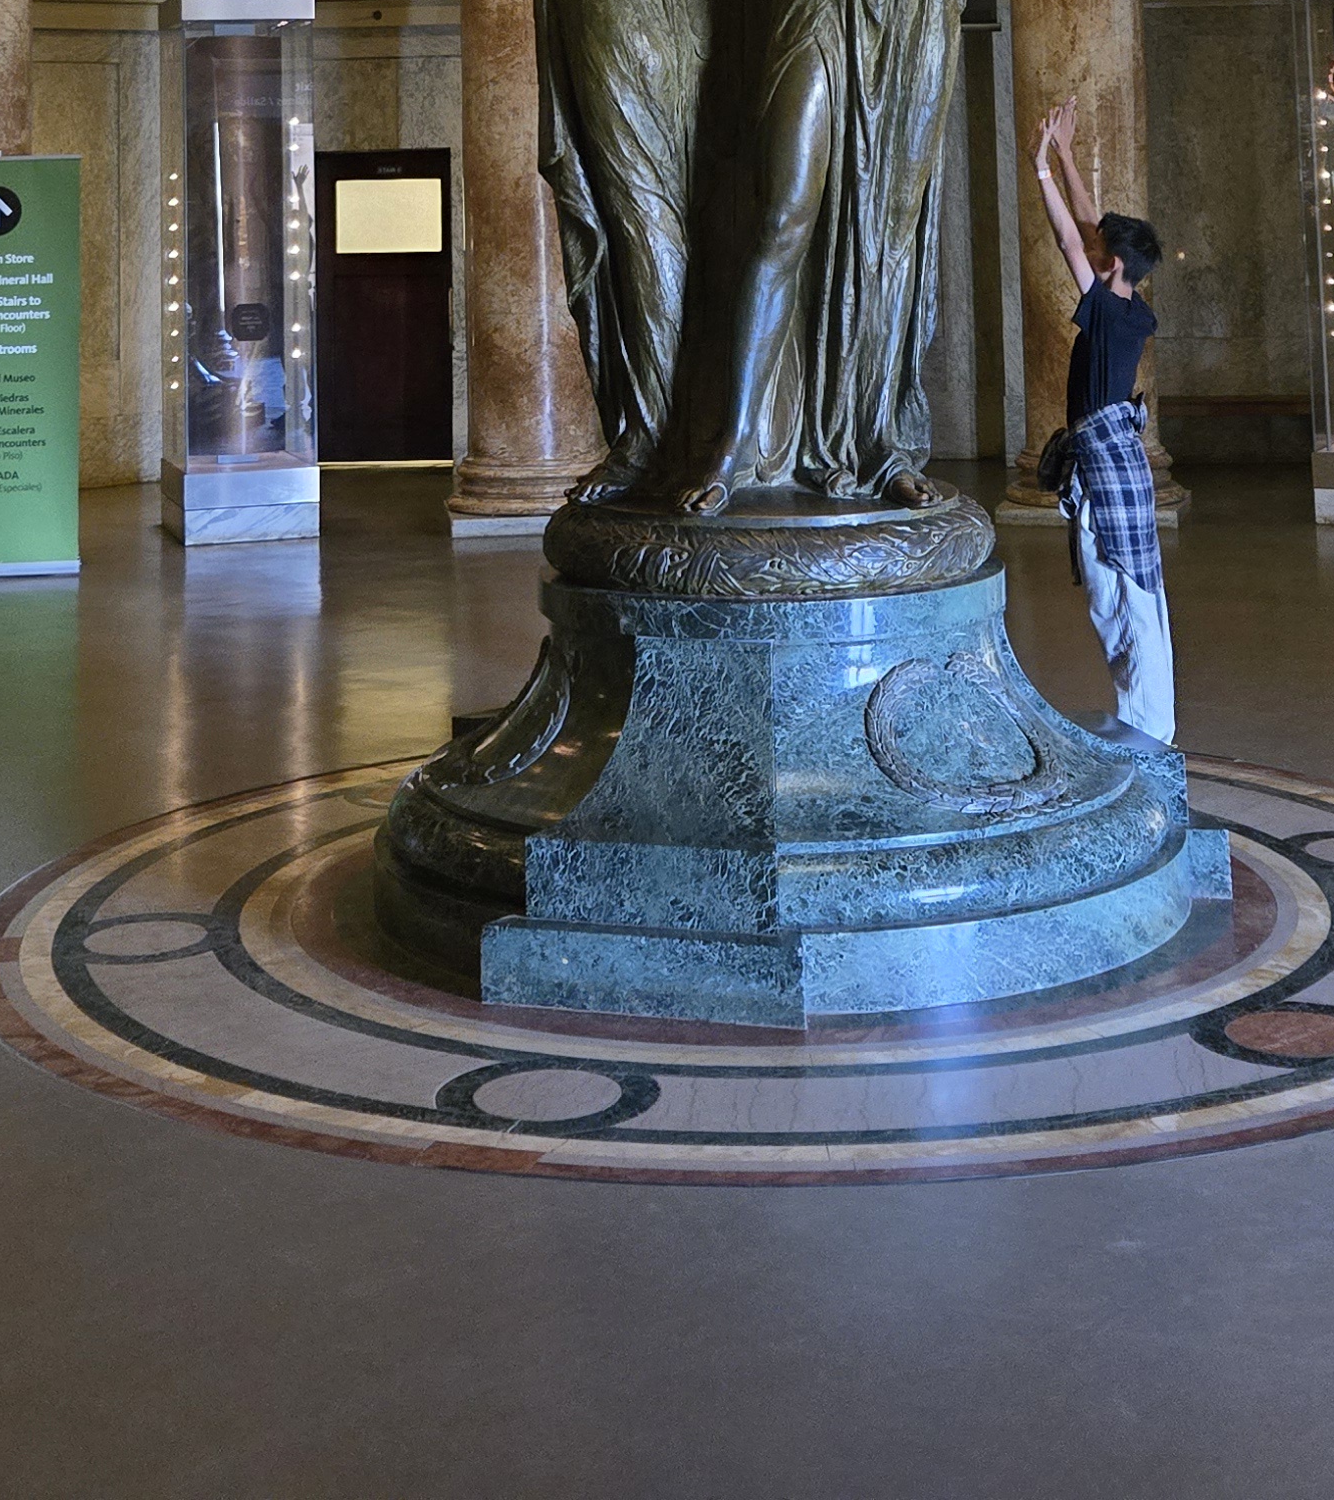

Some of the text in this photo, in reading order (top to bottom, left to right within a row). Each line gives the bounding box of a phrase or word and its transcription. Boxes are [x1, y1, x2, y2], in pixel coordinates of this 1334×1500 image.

[5, 253, 34, 264] Store
[31, 273, 54, 284] Hall
[29, 296, 42, 306] to
[0, 322, 26, 334] Floor)
[3, 374, 36, 384] Museo
[3, 451, 24, 461] Piso)
